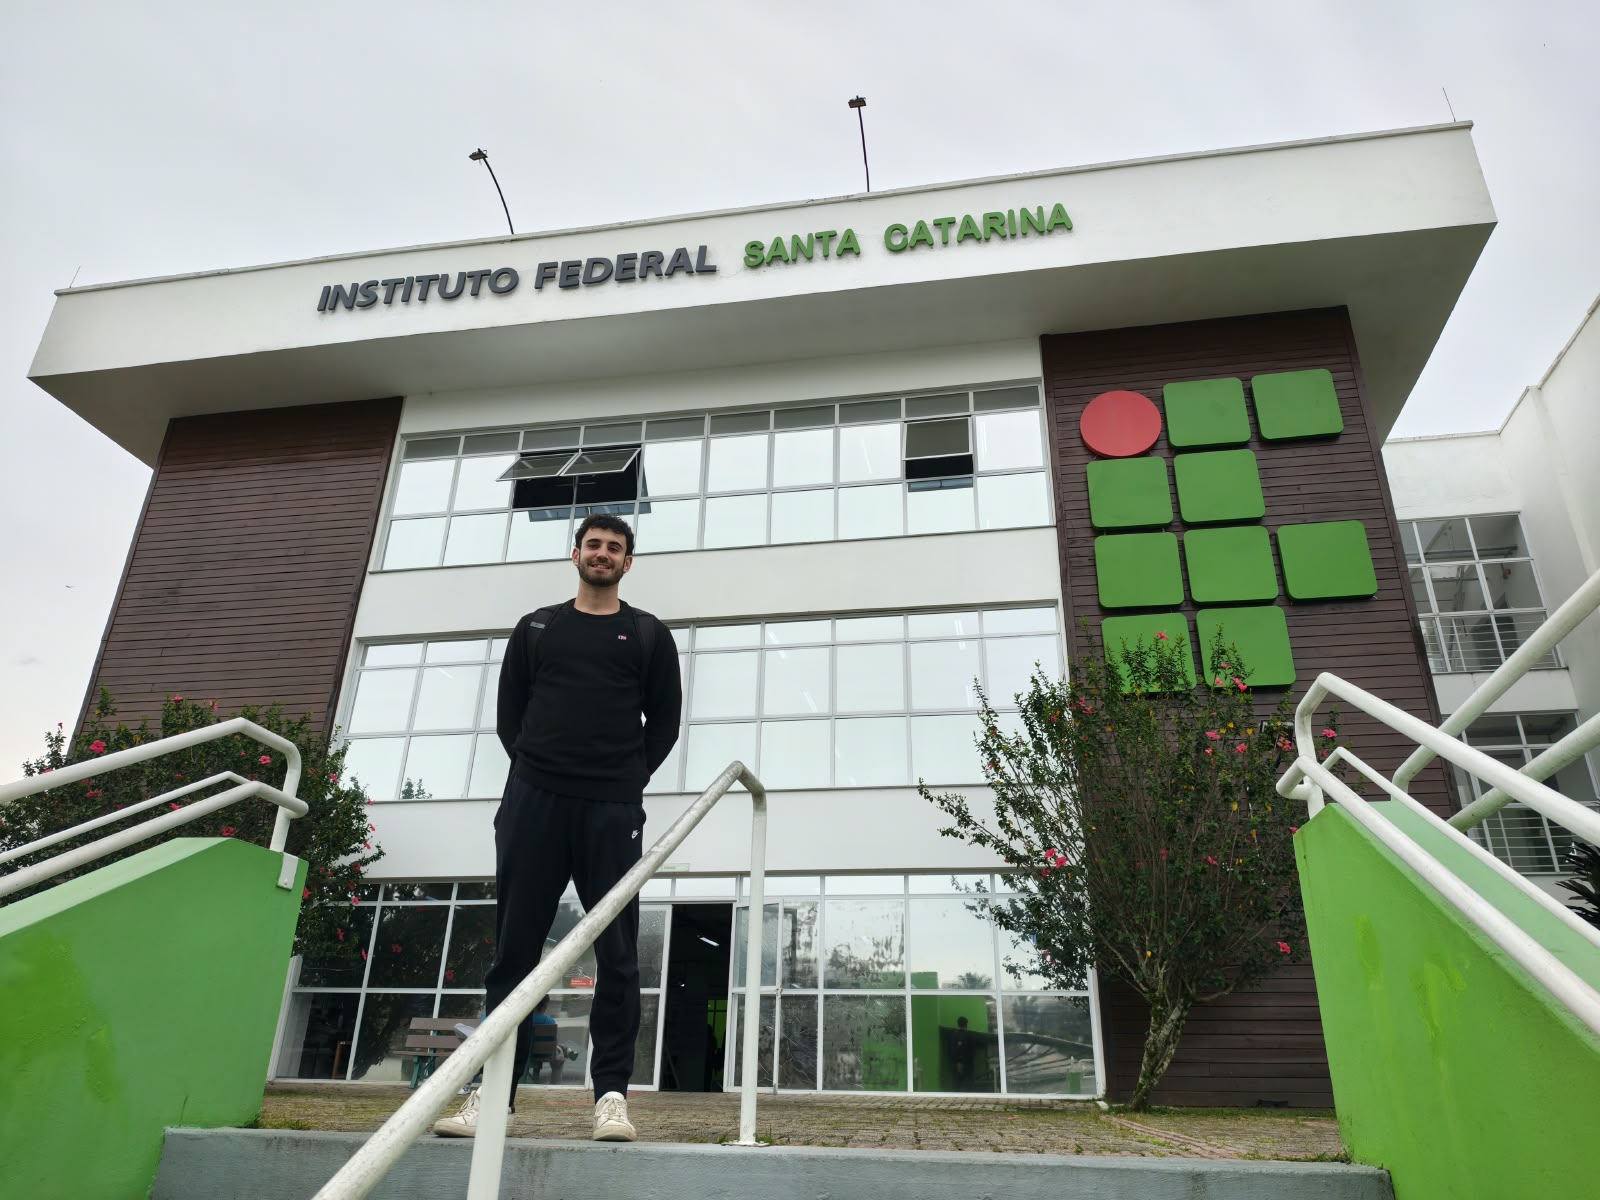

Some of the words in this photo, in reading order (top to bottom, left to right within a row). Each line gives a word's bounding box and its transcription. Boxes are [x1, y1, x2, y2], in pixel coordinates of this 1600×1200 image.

[317, 267, 519, 312] INSTITUTO
[534, 245, 717, 290] FEDERAL
[743, 228, 861, 268] SANTA
[884, 203, 1073, 253] CATARINA
